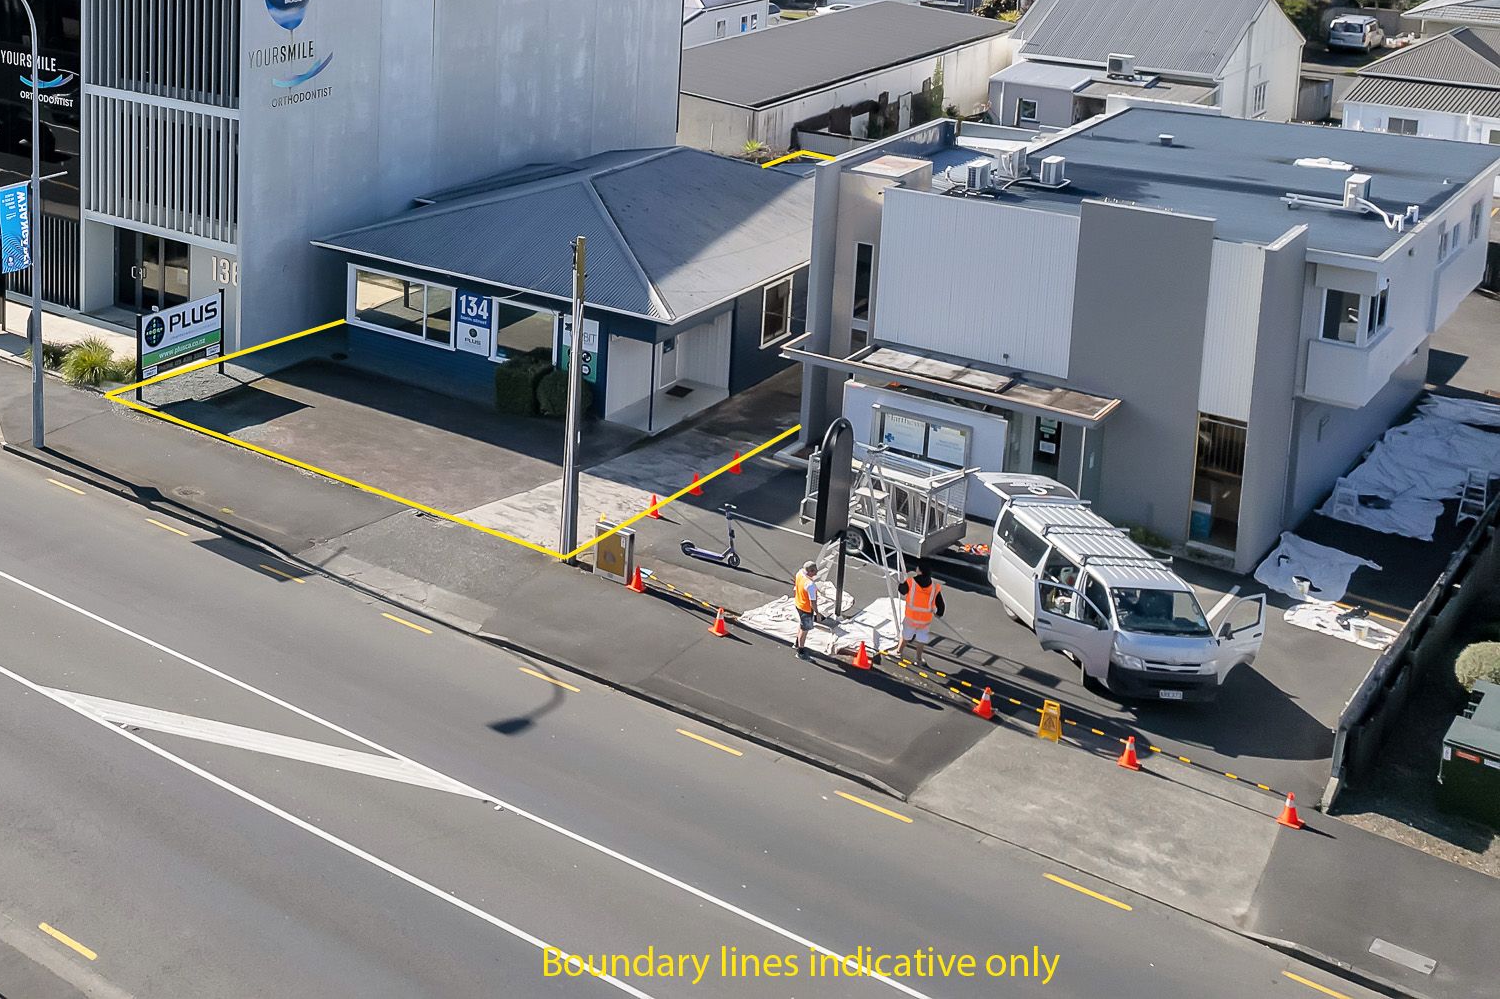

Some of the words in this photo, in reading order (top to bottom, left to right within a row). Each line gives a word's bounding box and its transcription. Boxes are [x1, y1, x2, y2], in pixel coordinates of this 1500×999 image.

[248, 40, 315, 69] YOURSMILE
[20, 90, 74, 108] ORTODONTIST
[271, 87, 333, 108] ORTHODONTIST
[169, 300, 218, 333] PLUS
[459, 294, 489, 320] 134
[158, 338, 206, 359] www.plusca.co.nz
